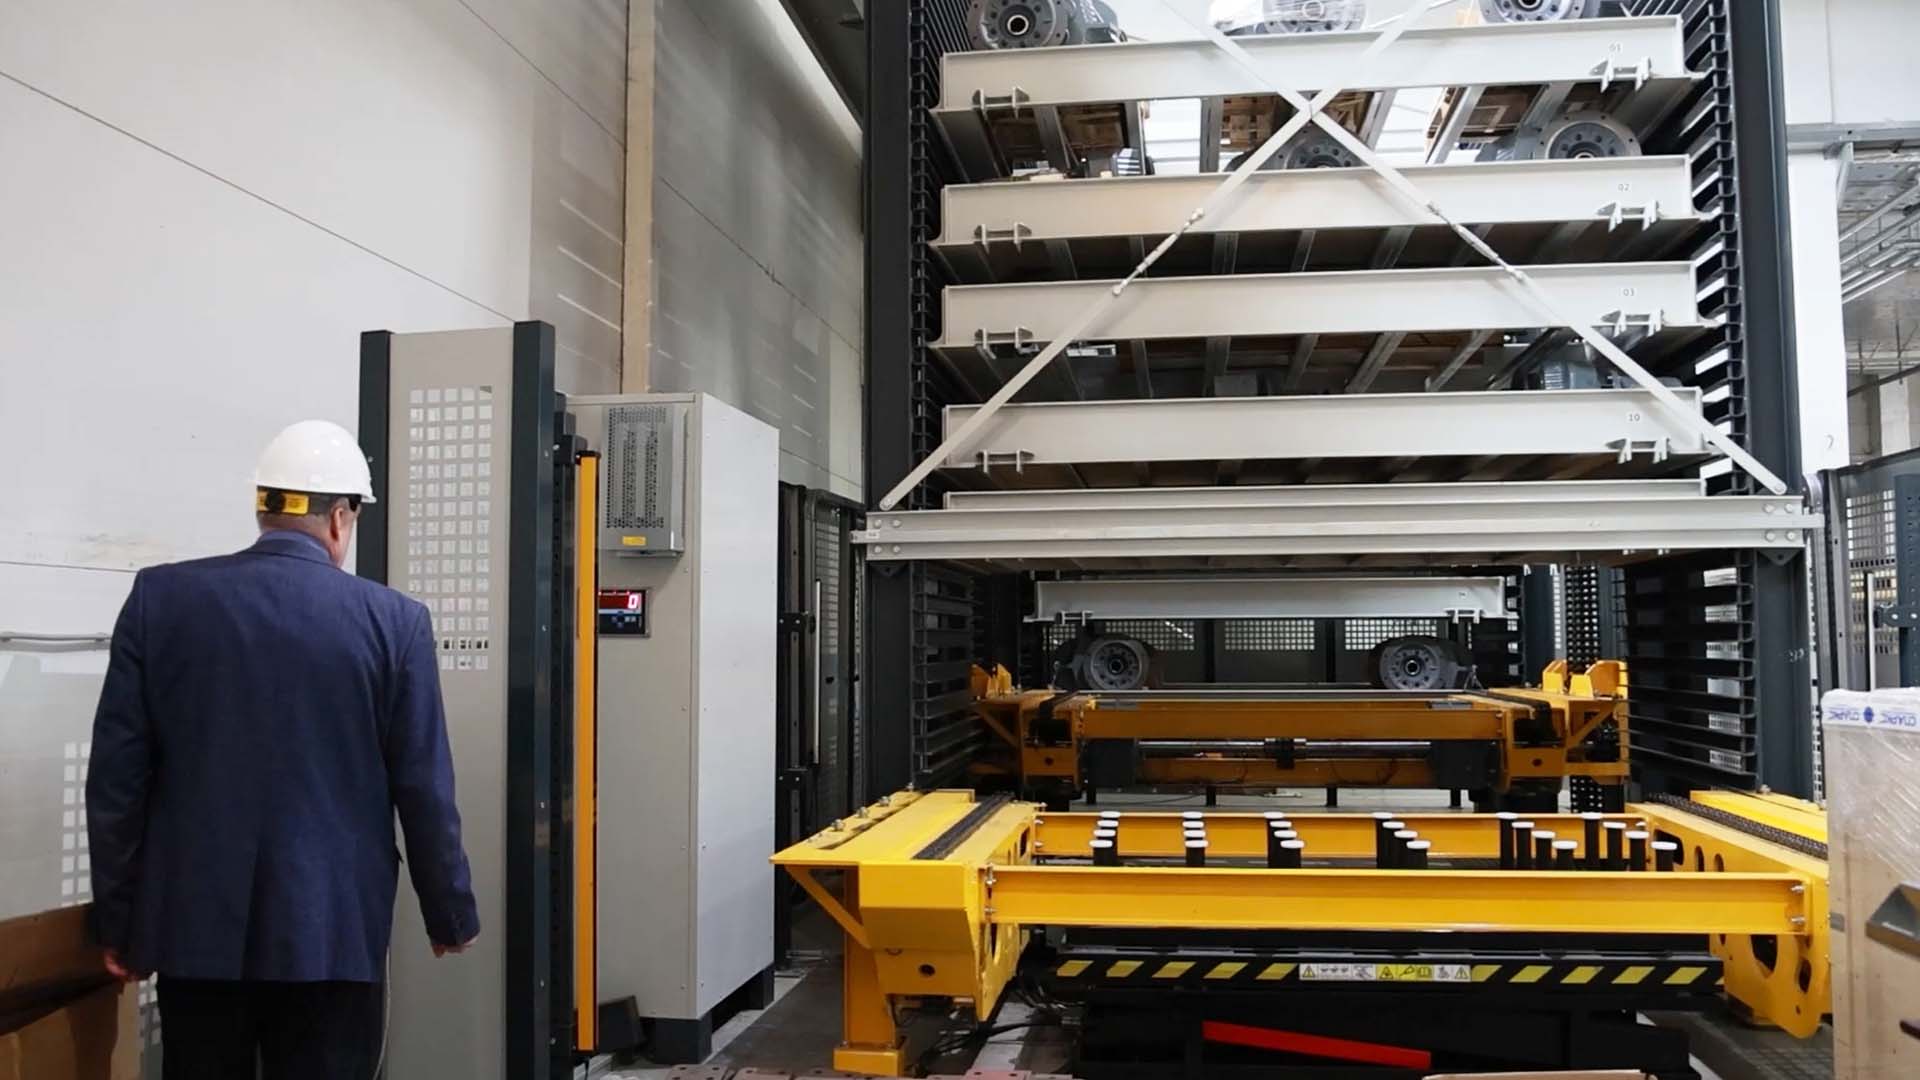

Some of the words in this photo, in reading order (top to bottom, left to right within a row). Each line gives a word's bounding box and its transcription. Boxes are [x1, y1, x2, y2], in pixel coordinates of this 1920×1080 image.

[1617, 182, 1630, 193] 02
[1628, 412, 1641, 423] 10
[627, 593, 639, 609] 0
